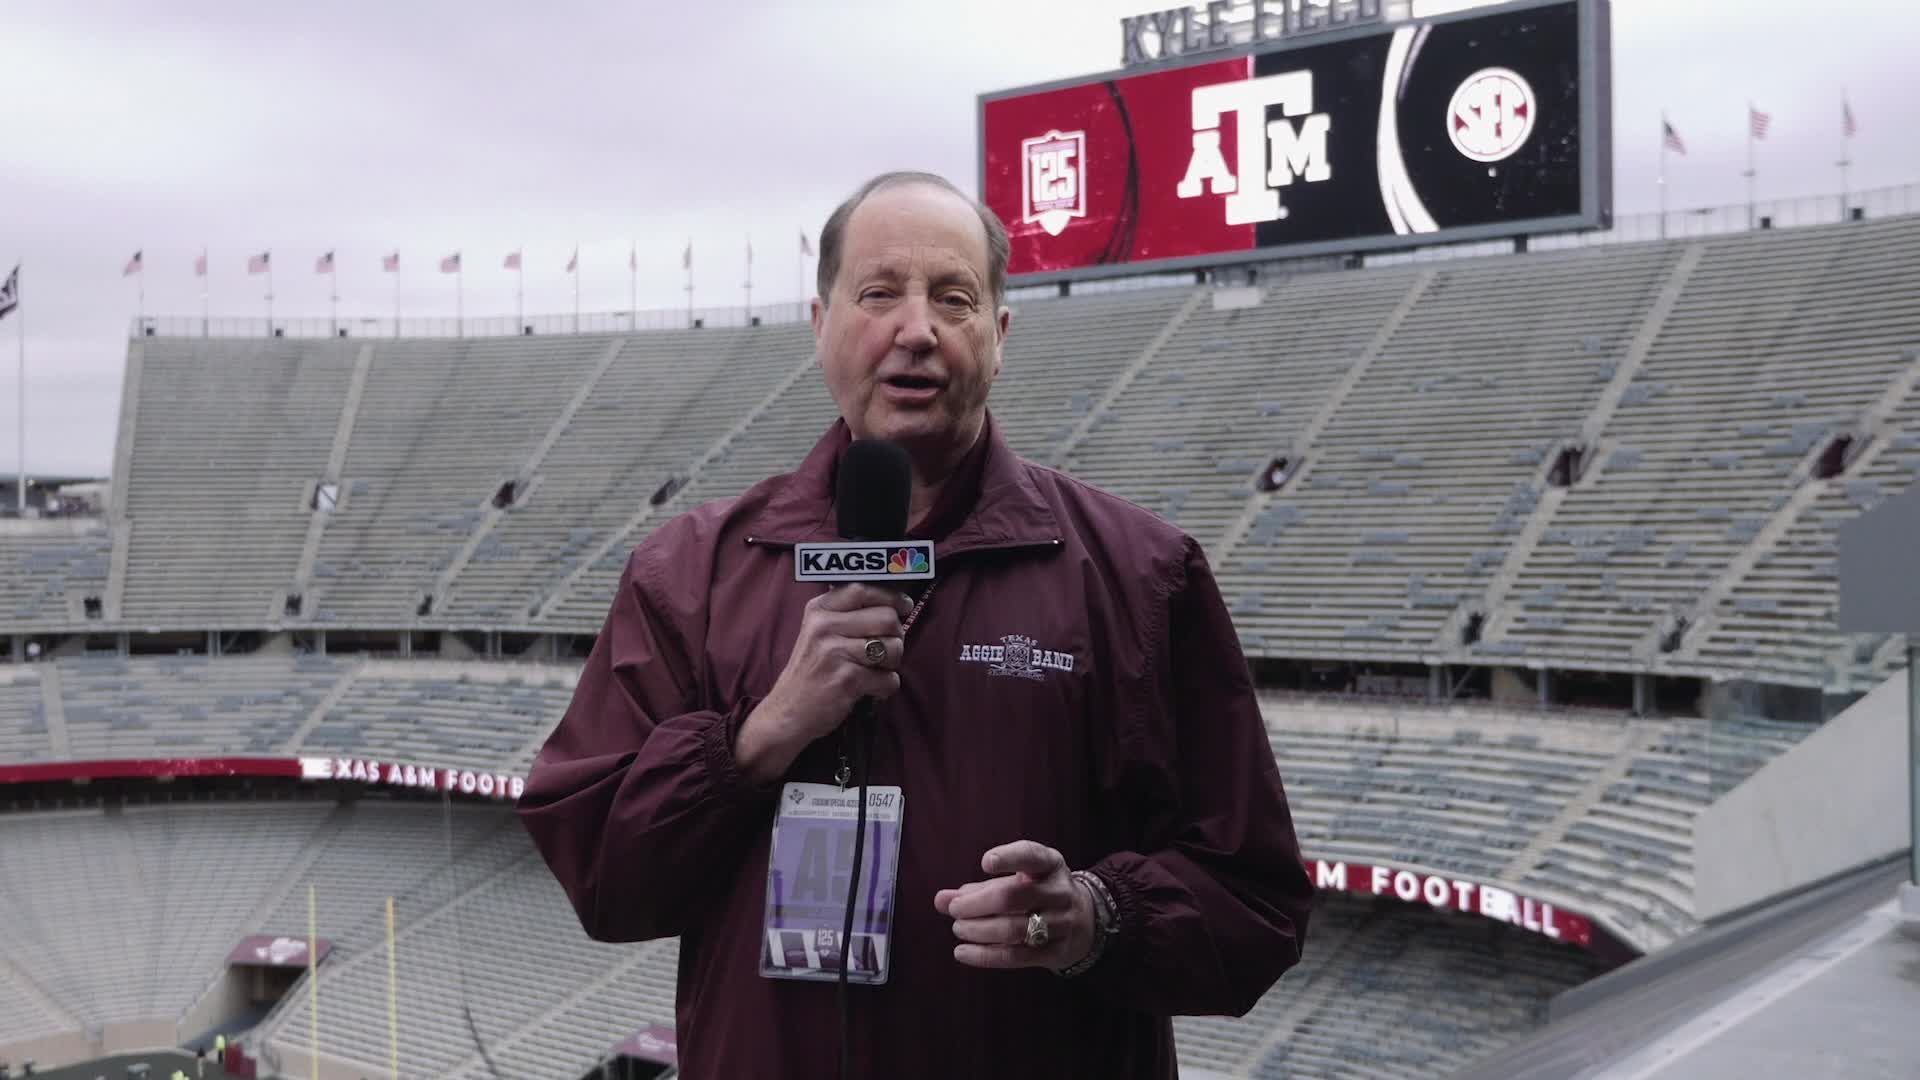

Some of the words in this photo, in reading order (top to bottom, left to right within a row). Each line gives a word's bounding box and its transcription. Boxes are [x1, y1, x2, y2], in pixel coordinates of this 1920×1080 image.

[1120, 0, 1232, 65] KYLE
[1455, 76, 1527, 156] SEC
[1031, 149, 1077, 203] 125
[803, 552, 885, 571] KAGS
[999, 634, 1038, 647] TEXAS
[959, 645, 1005, 662] AGGIE
[1032, 649, 1074, 672] BAND
[388, 763, 435, 787] A&M
[868, 793, 895, 808] 0547
[1371, 865, 1560, 938] FOOTBALL
